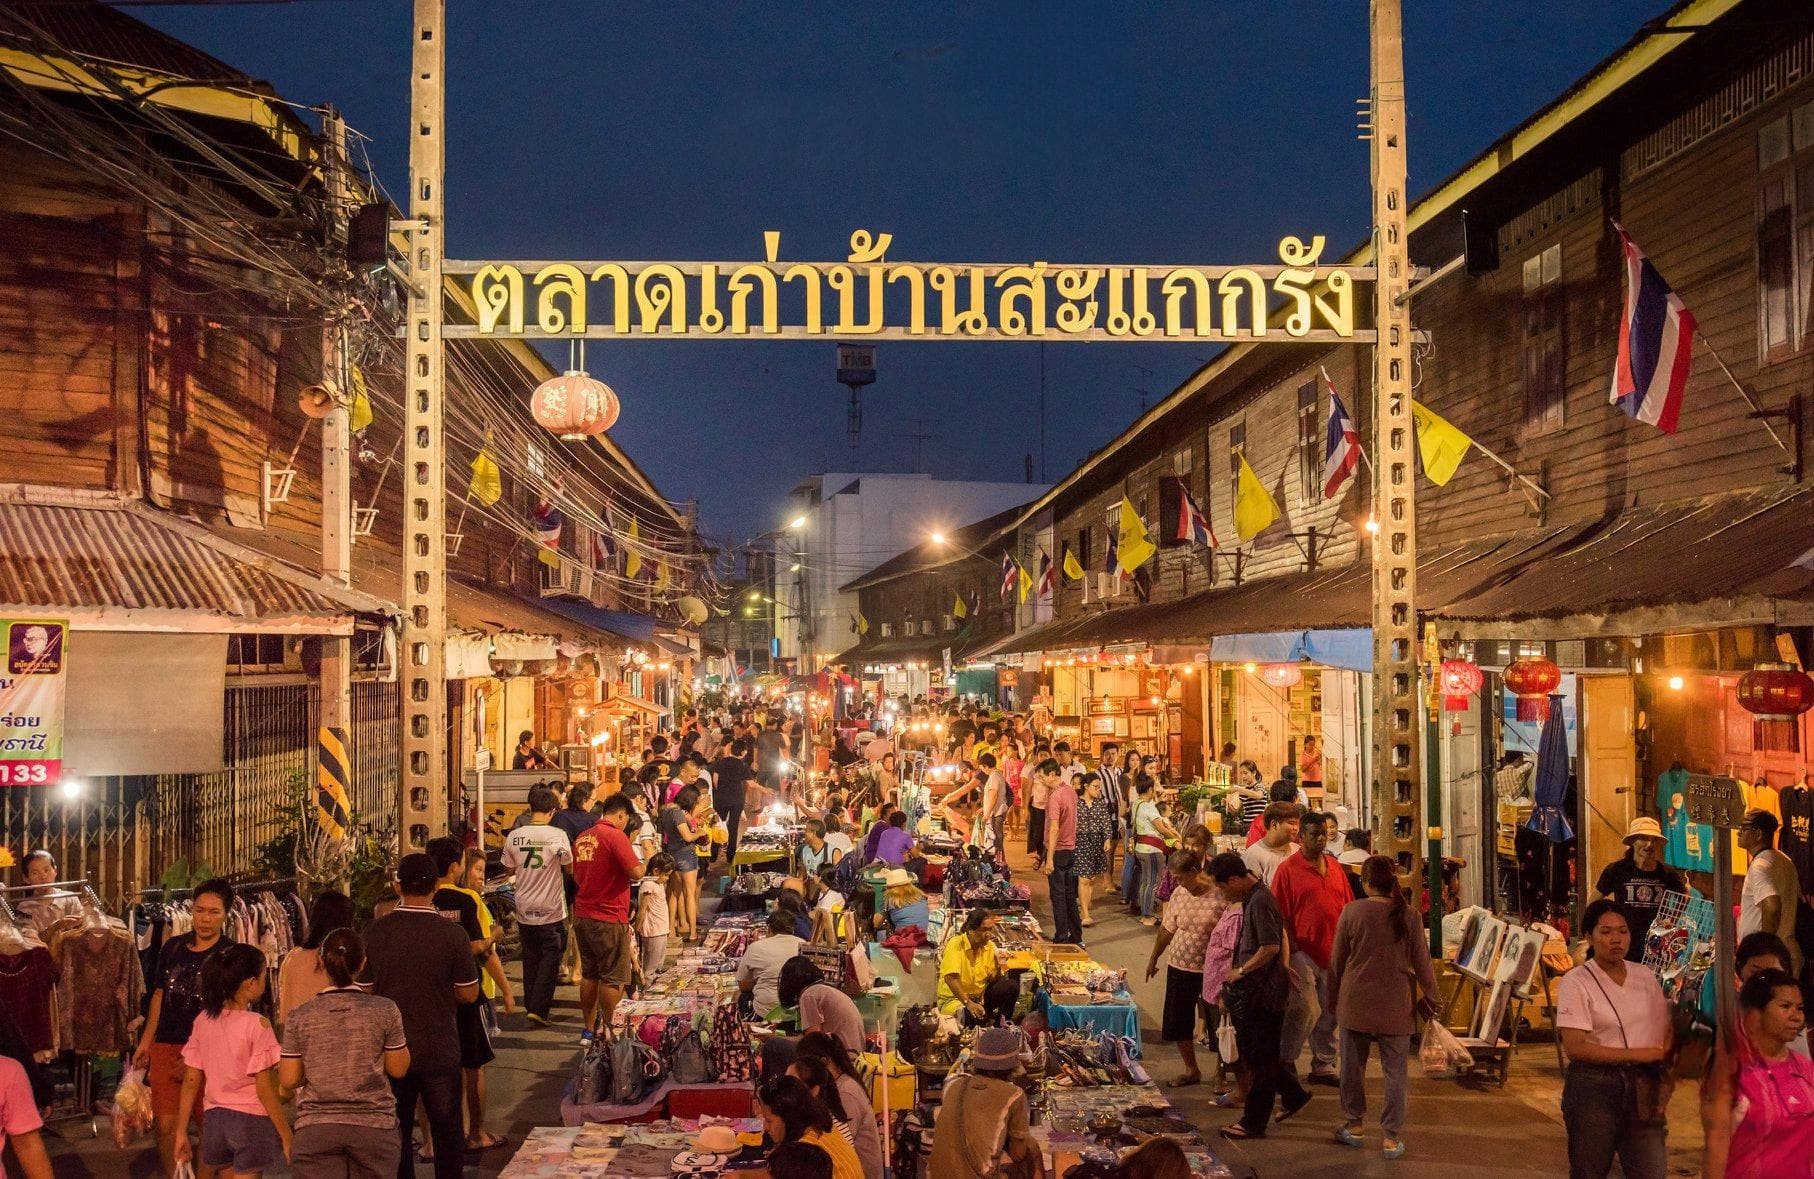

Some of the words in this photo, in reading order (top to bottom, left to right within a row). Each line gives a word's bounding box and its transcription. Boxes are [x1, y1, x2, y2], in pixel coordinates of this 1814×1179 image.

[472, 229, 1354, 337] ตลาดเก่าบ้านสะแกกรัง
[843, 353, 872, 366] TMB
[0, 733, 47, 751] ธานี
[513, 837, 526, 846] EIT
[519, 847, 544, 869] 75
